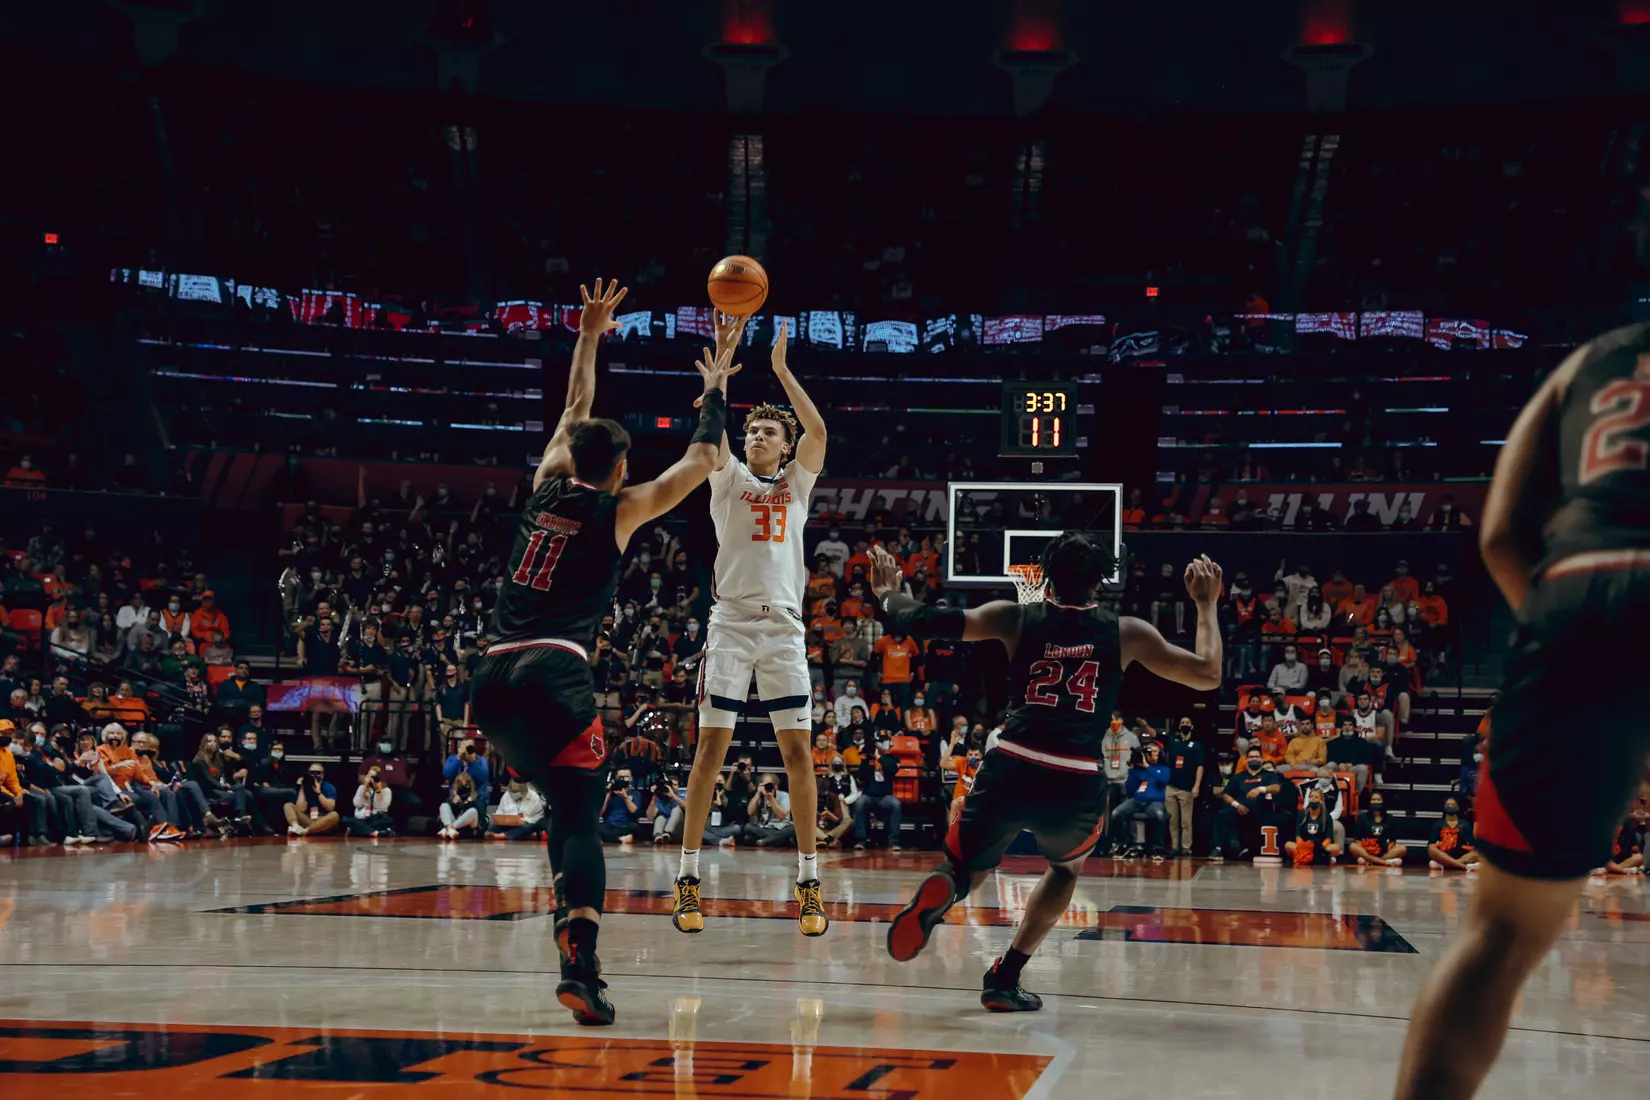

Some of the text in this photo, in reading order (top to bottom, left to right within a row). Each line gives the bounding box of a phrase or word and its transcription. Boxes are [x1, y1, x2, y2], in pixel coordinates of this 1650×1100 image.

[1026, 391, 1067, 413] 3:37
[1031, 416, 1060, 448] 11
[740, 491, 791, 505] ILLINOIS
[751, 505, 787, 542] 33
[512, 529, 568, 592] 11
[1044, 642, 1095, 659] LONDON
[1025, 660, 1100, 713] 24
